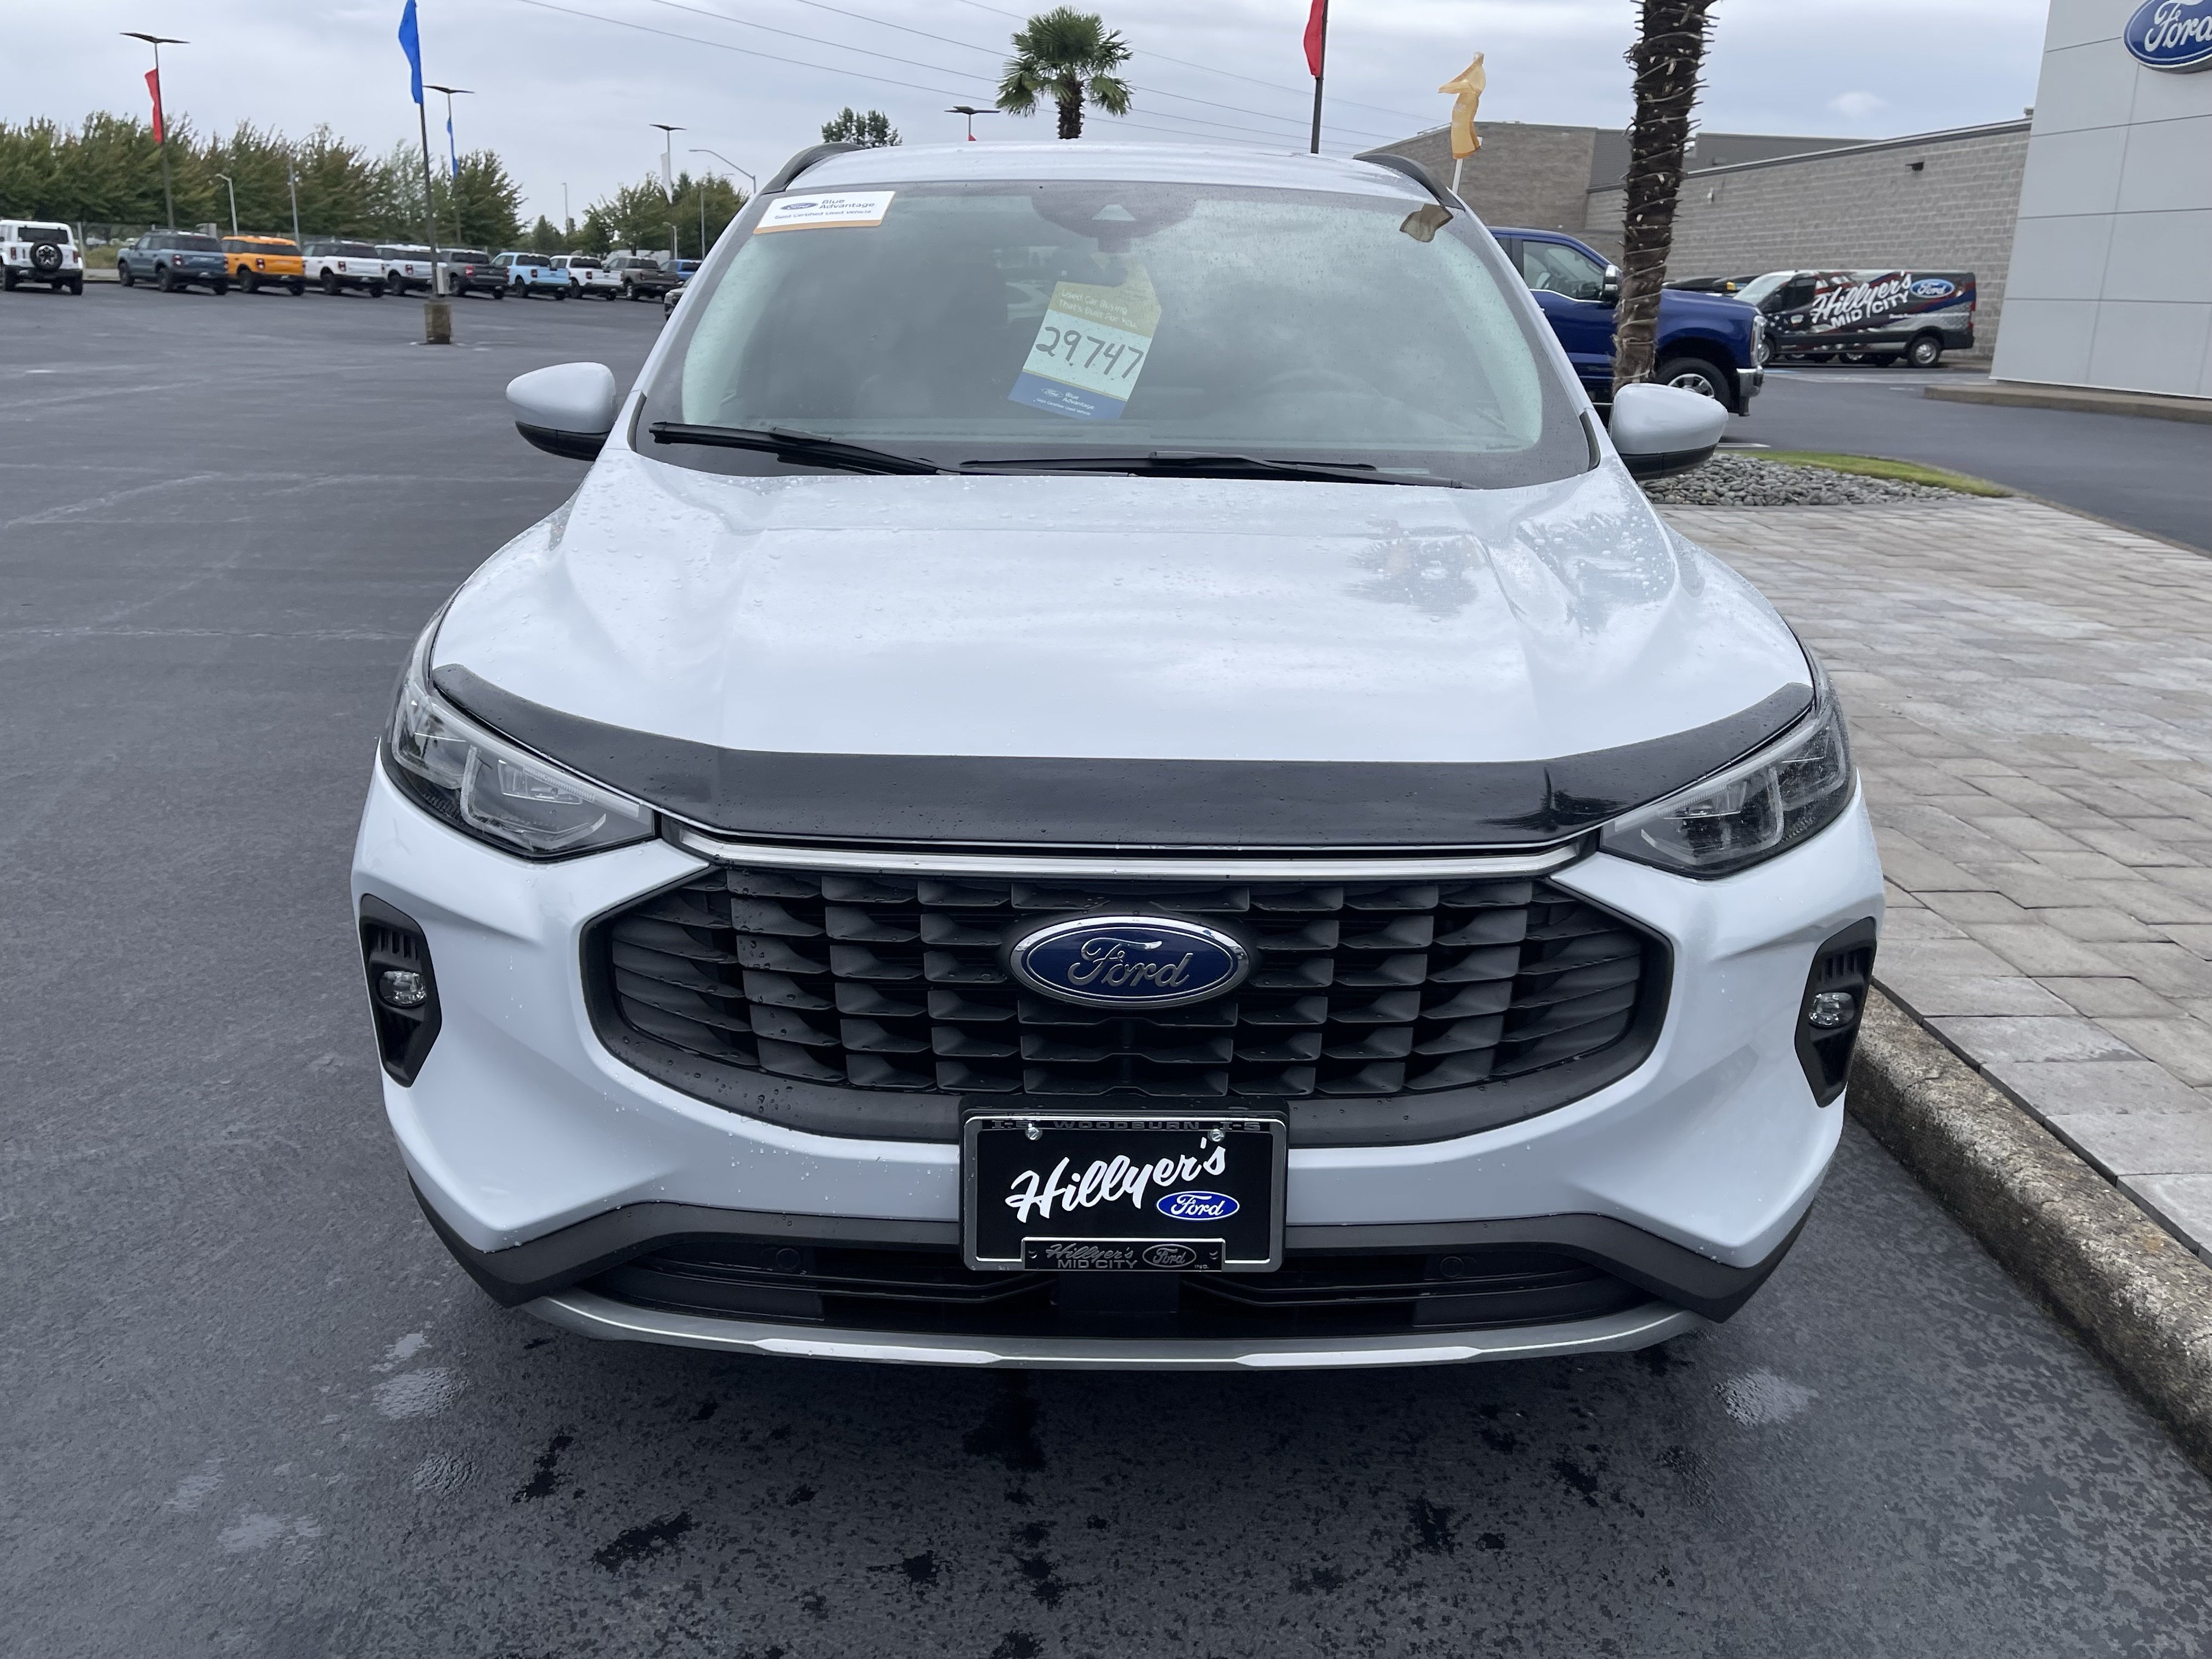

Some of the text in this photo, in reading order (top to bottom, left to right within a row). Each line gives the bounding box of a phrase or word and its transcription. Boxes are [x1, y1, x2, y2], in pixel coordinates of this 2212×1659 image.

[1810, 270, 1912, 324] Hillyer's
[1918, 282, 1946, 294] Ford
[1059, 299, 1082, 312] That's
[1084, 307, 1103, 318] Built
[1105, 313, 1118, 321] For
[1061, 289, 1127, 315] Used Car Buying
[1830, 290, 1909, 329] MID CITY
[1035, 326, 1144, 379] 29747
[1062, 397, 1094, 410] Advantage
[1068, 937, 1194, 988] Ford
[1053, 1121, 1200, 1130] WOODBURN
[1005, 1137, 1226, 1223] Hillyer's
[1170, 1194, 1226, 1216] Ford
[1045, 1243, 1134, 1262] Hillyer's
[1153, 1247, 1186, 1265] Ford
[1057, 1260, 1138, 1269] MID CITY
